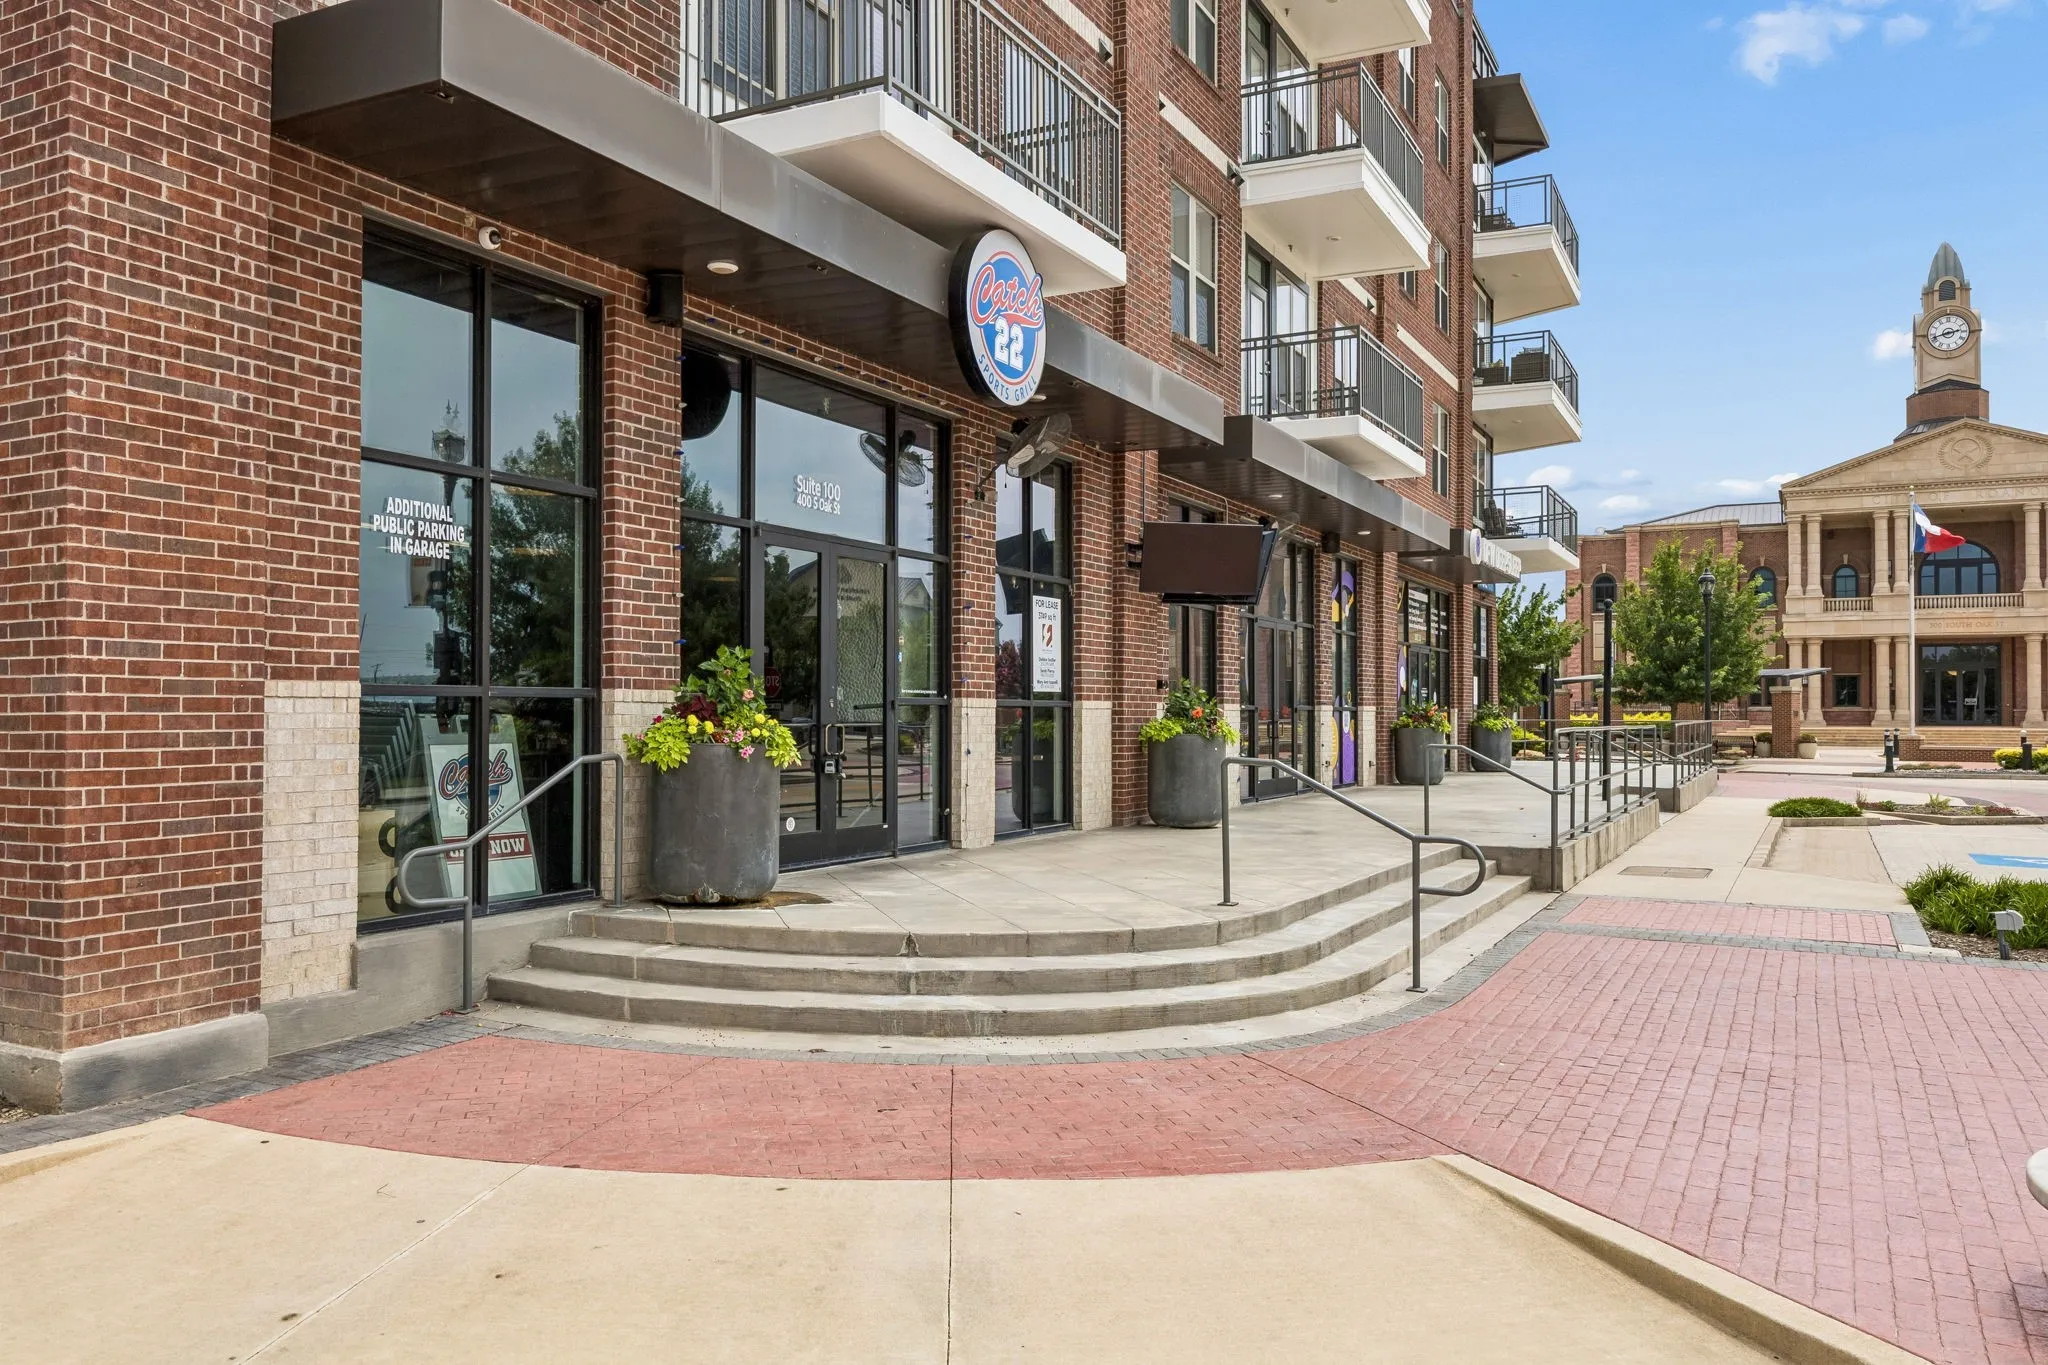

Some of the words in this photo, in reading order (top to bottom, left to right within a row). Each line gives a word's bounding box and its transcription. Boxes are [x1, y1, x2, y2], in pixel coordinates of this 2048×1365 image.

[971, 264, 1043, 327] Catch
[994, 316, 1023, 371] 22
[978, 354, 1009, 400] SPORTS
[1014, 376, 1037, 402] GRILL
[797, 474, 821, 496] Suite
[824, 481, 841, 501] 100
[387, 496, 453, 522] ADDITIONAL
[797, 494, 812, 508] 400
[813, 496, 818, 509] S
[819, 498, 833, 513] Oak
[834, 501, 841, 515] St
[373, 514, 415, 536] PUBLIC
[418, 520, 465, 543] PARKING
[390, 536, 402, 554] IN
[405, 538, 450, 560] GARAGE
[1035, 599, 1044, 607] FOR
[1046, 600, 1059, 610] LEASE
[439, 749, 514, 800] Cah
[489, 838, 525, 855] NOW
